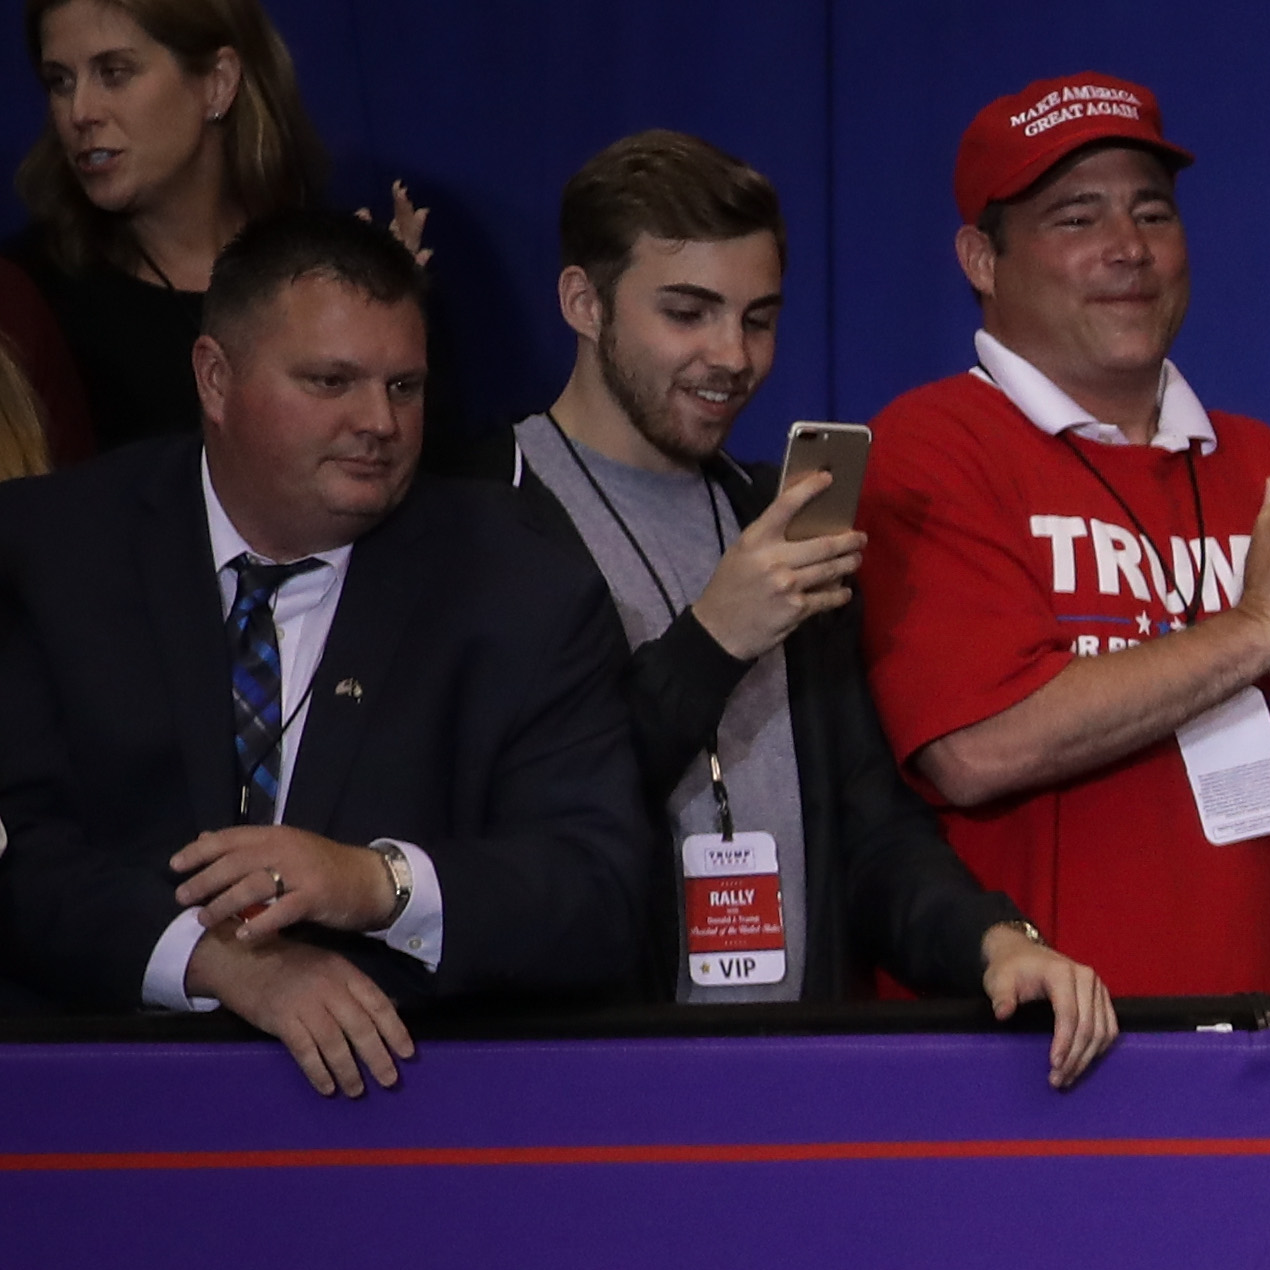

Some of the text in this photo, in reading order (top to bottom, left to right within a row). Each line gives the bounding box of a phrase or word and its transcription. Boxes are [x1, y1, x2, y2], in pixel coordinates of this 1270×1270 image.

[1010, 85, 1141, 127] MAKE AMERICA
[1025, 102, 1140, 137] GREAT AGAIN
[709, 850, 750, 859] TRUMP
[710, 889, 755, 907] RALLY
[719, 958, 756, 979] VIP
